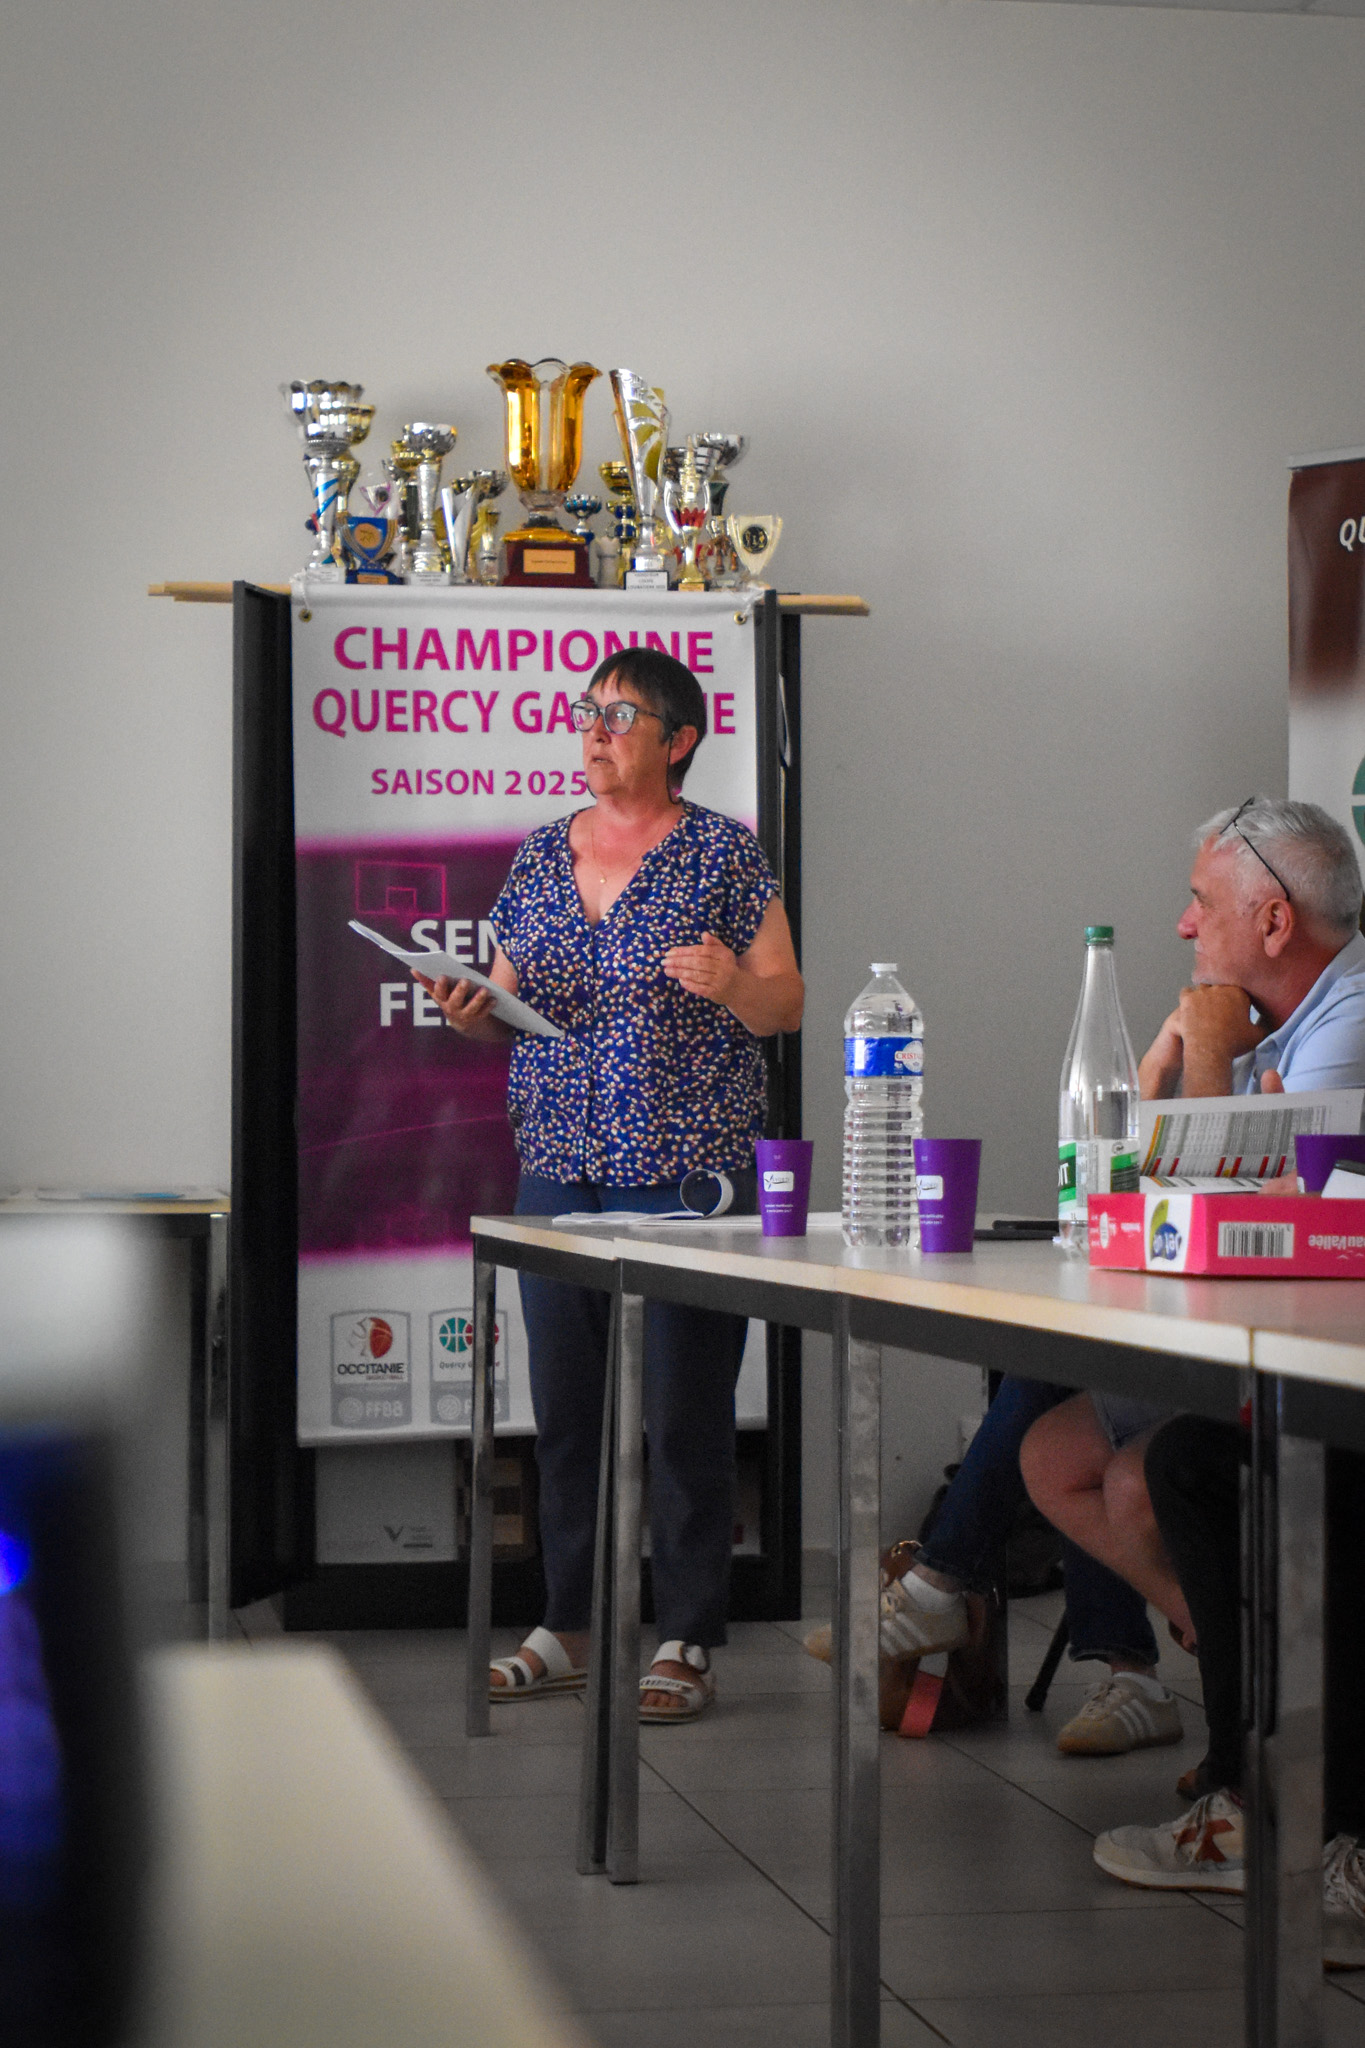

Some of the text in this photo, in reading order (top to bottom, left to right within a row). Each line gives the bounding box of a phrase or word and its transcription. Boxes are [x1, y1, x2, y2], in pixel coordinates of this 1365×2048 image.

[312, 687, 500, 738] QUERCY
[371, 768, 494, 795] SAISON
[337, 1363, 405, 1375] OCCITANIE
